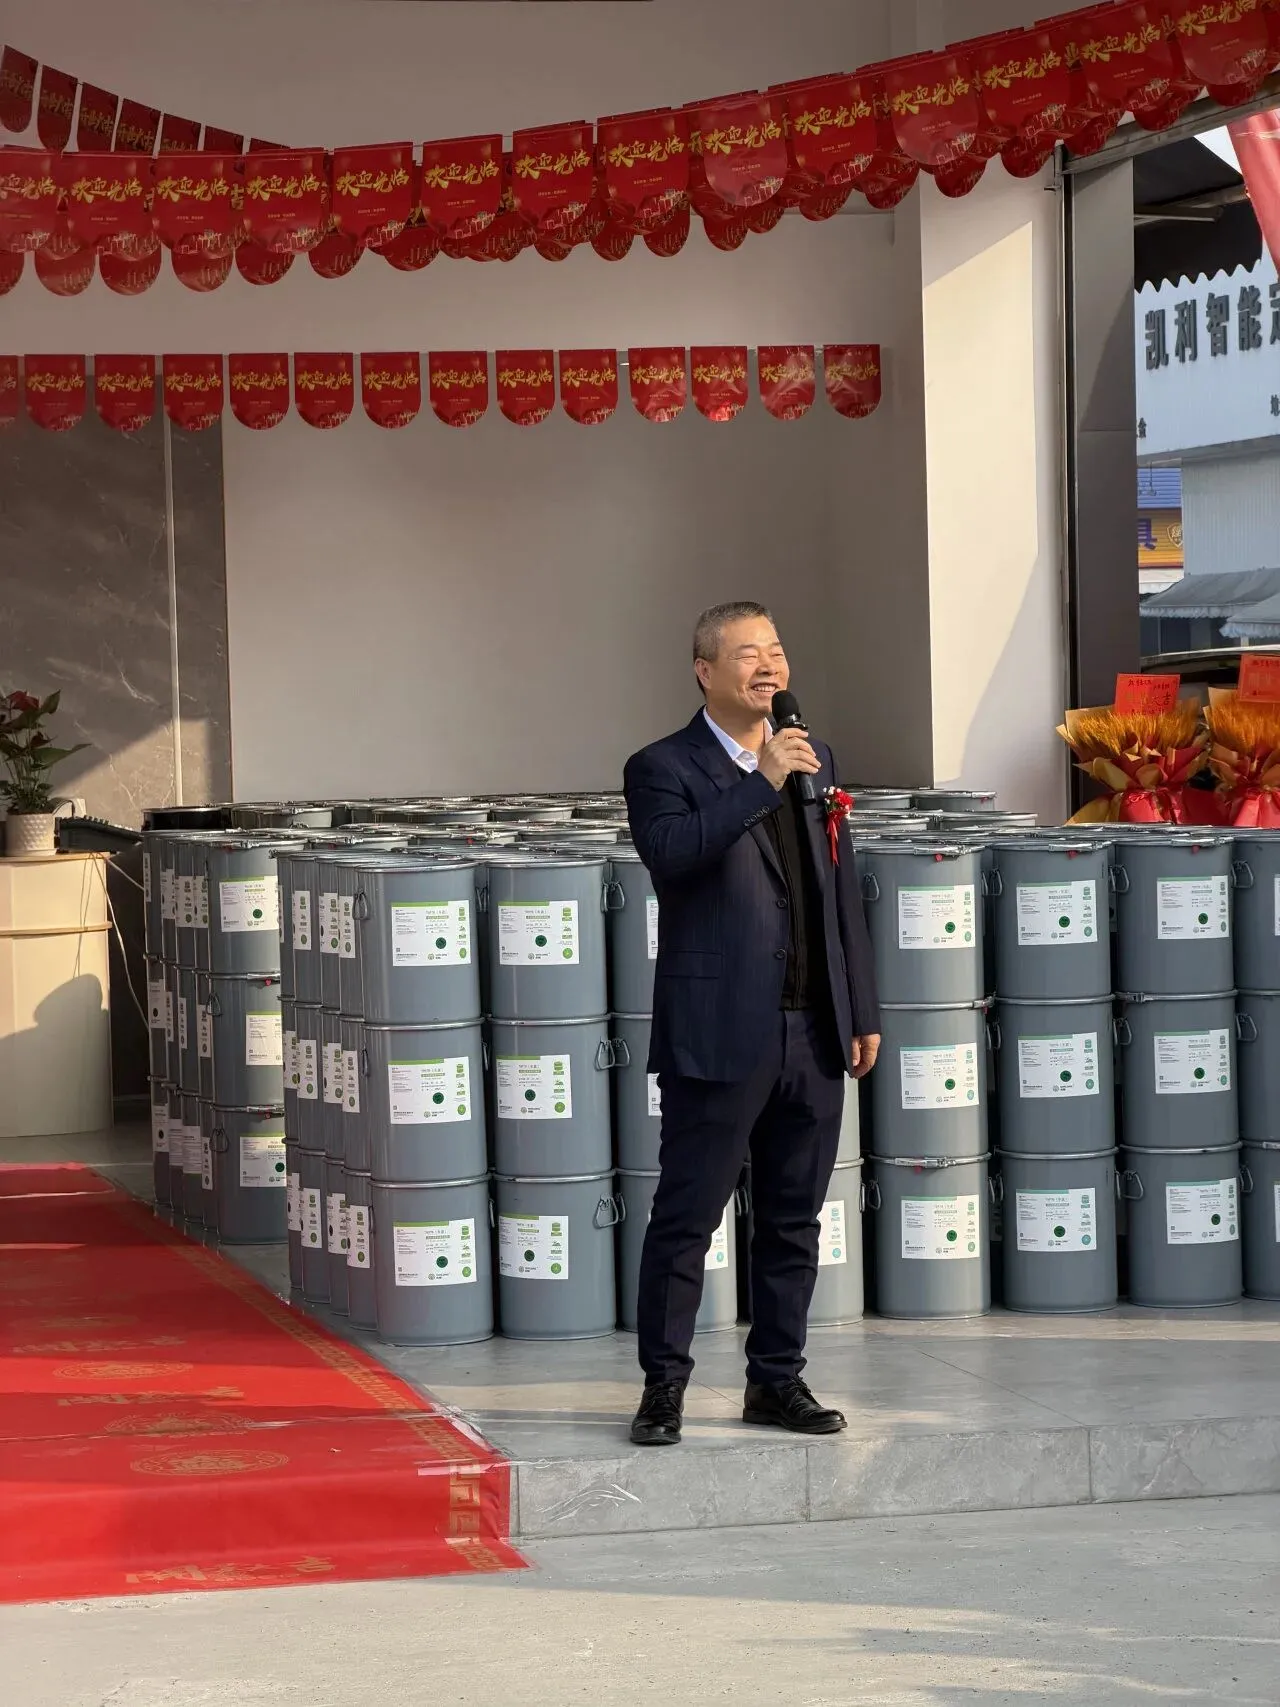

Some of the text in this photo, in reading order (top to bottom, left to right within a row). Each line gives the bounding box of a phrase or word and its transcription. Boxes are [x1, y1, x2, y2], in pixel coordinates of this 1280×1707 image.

[1082, 23, 1161, 63] 欢迎光临
[983, 50, 1061, 89] 欢迎光临
[892, 78, 969, 115] 欢迎光临
[794, 100, 871, 135] 欢迎光临
[609, 134, 684, 168] 欢迎光临
[704, 120, 781, 156] 欢迎光临
[425, 160, 499, 189] 欢迎光临
[515, 149, 591, 178] 欢迎光临
[72, 176, 143, 203] 欢迎光临
[157, 175, 230, 202] 欢迎光临
[246, 174, 320, 202] 欢迎光临
[336, 168, 409, 197] 欢迎光临
[232, 371, 288, 392] 欢迎光临
[297, 369, 352, 391] 欢迎光临
[364, 370, 418, 392] 欢迎光临
[432, 369, 486, 390] 欢迎光临
[499, 368, 553, 389] 欢迎光临
[562, 367, 616, 389] 欢迎光临
[632, 364, 685, 385] 欢迎光临
[693, 364, 746, 385] 欢迎光临
